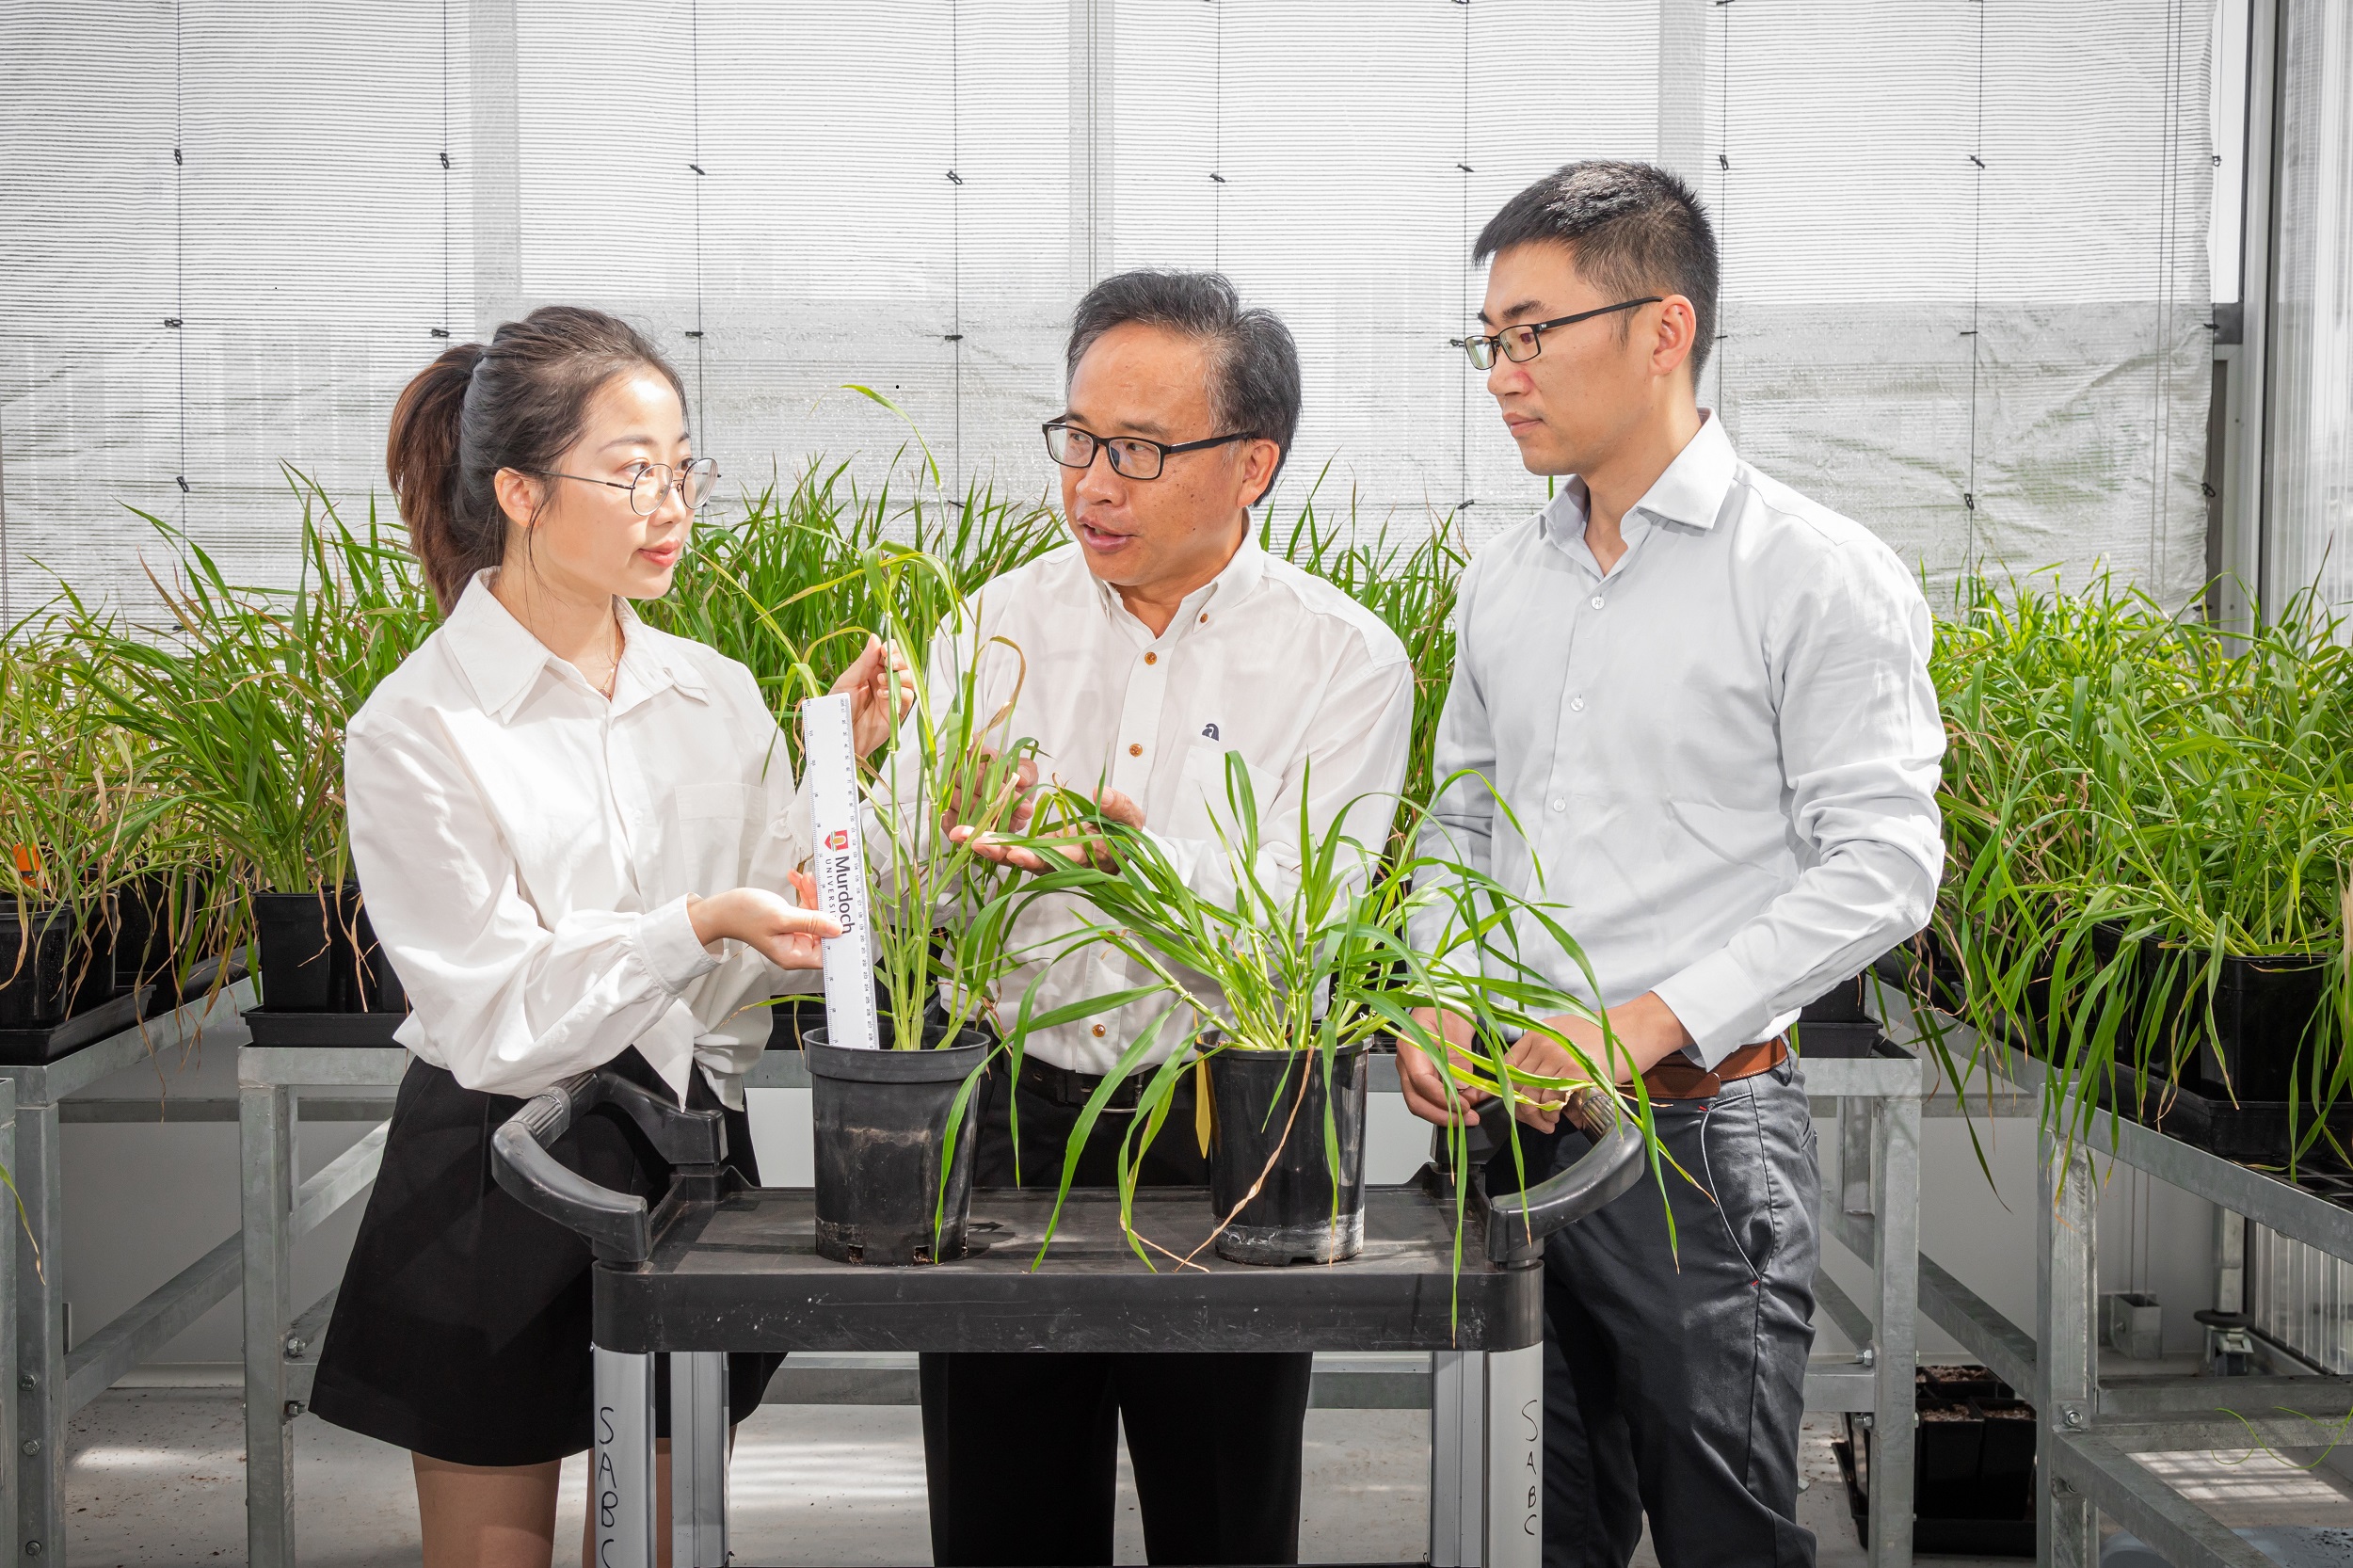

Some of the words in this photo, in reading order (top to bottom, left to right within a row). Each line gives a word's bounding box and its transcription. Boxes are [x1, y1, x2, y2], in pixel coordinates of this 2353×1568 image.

[825, 858, 836, 918] UNIVERSI
[835, 856, 856, 934] Murdoch
[1521, 1399, 1539, 1536] SABC
